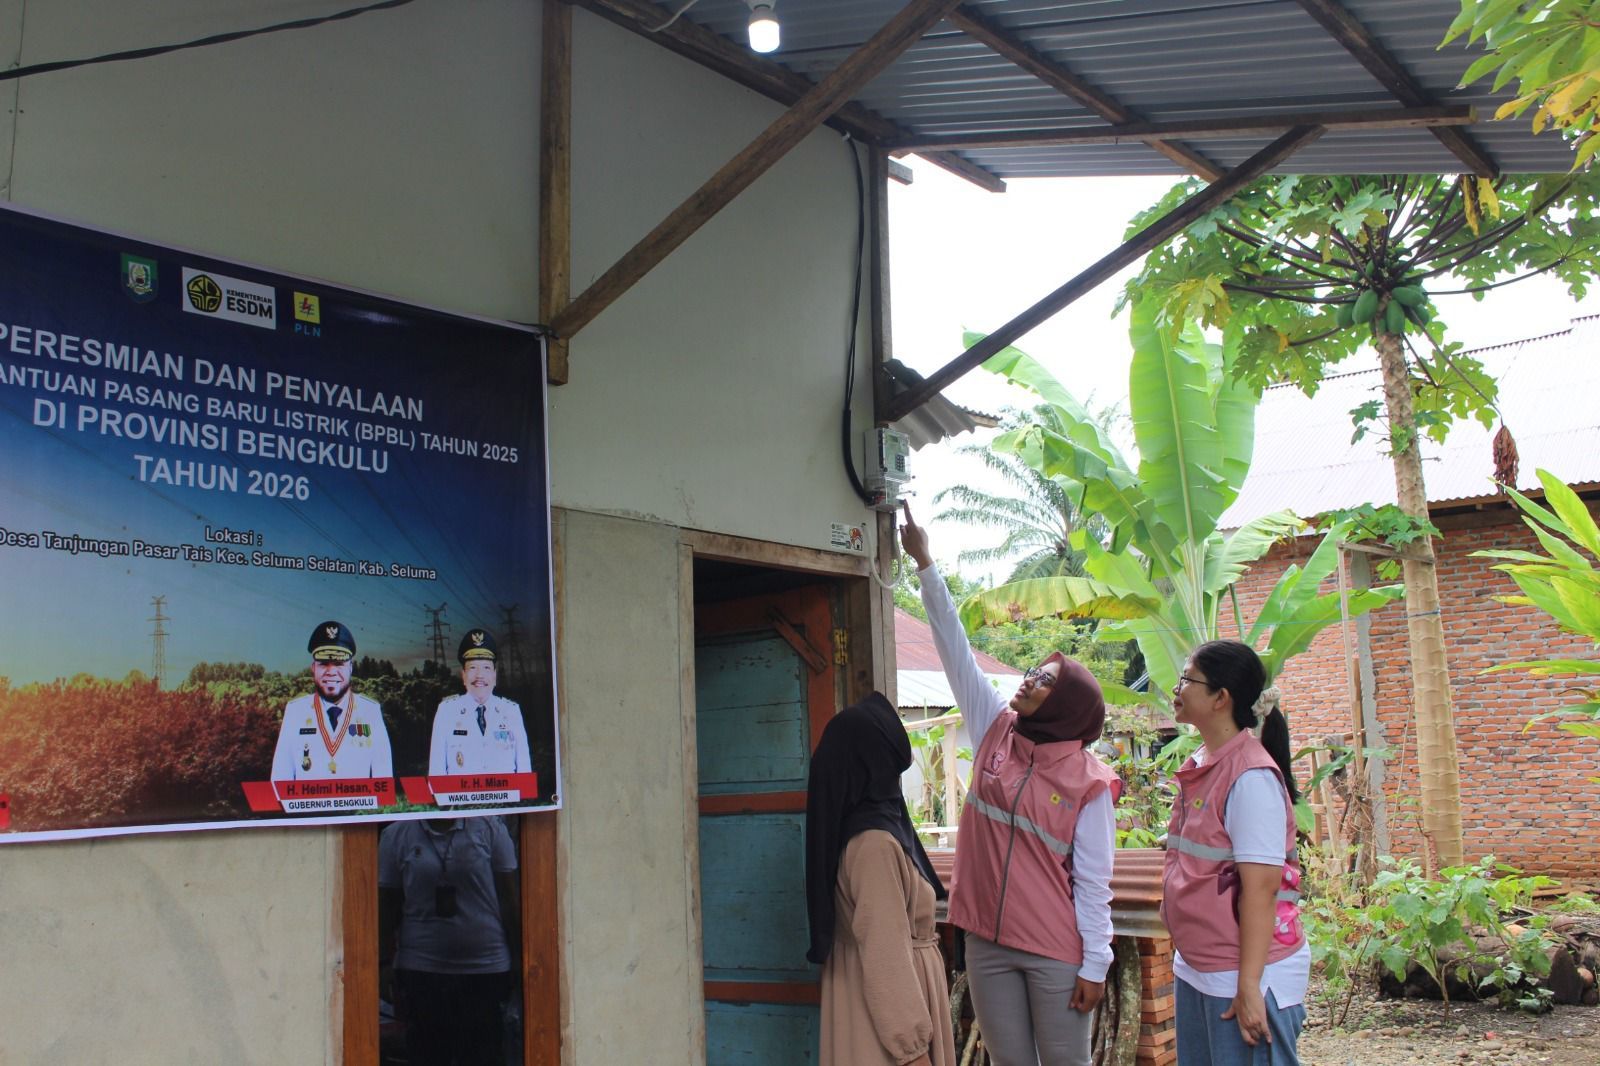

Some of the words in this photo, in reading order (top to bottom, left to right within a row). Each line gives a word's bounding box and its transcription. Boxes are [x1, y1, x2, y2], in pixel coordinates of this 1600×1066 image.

[226, 288, 273, 304] KEMENTERIAN
[226, 296, 273, 319] ESDM
[294, 322, 321, 337] PLN
[194, 358, 256, 393] DAN
[266, 371, 423, 422] PENYALAAN
[104, 380, 200, 413] PASANG
[206, 397, 267, 424] BARU
[273, 408, 349, 437] LISTRIK
[354, 421, 416, 451] (BPBL)
[420, 432, 478, 457] TAHUN
[482, 443, 519, 463] 2025
[33, 398, 67, 429] DI
[77, 404, 228, 452] PROVINSI
[237, 428, 388, 474] BENGKULU
[133, 454, 239, 492] TAHUN
[247, 470, 310, 501] 2026
[205, 527, 254, 545] Lokasi
[43, 531, 130, 557] Tanjungan
[132, 540, 179, 559] Pasar
[181, 545, 213, 562] Tais
[215, 549, 249, 564] Kec.
[252, 552, 304, 570] Seluma
[308, 556, 356, 574] Selatan
[359, 560, 388, 577] Kab.
[391, 563, 437, 580] Seluma
[286, 784, 299, 796] H.
[301, 783, 333, 795] Helmi
[335, 782, 371, 793] Hasan,
[373, 781, 388, 792] SE
[472, 779, 483, 789] H.
[485, 777, 509, 788] Mian
[288, 800, 332, 810] GUBERNUR
[333, 798, 374, 808] BENGKULU
[448, 794, 470, 802] WAKIL
[470, 792, 509, 801] GUBERNUR
